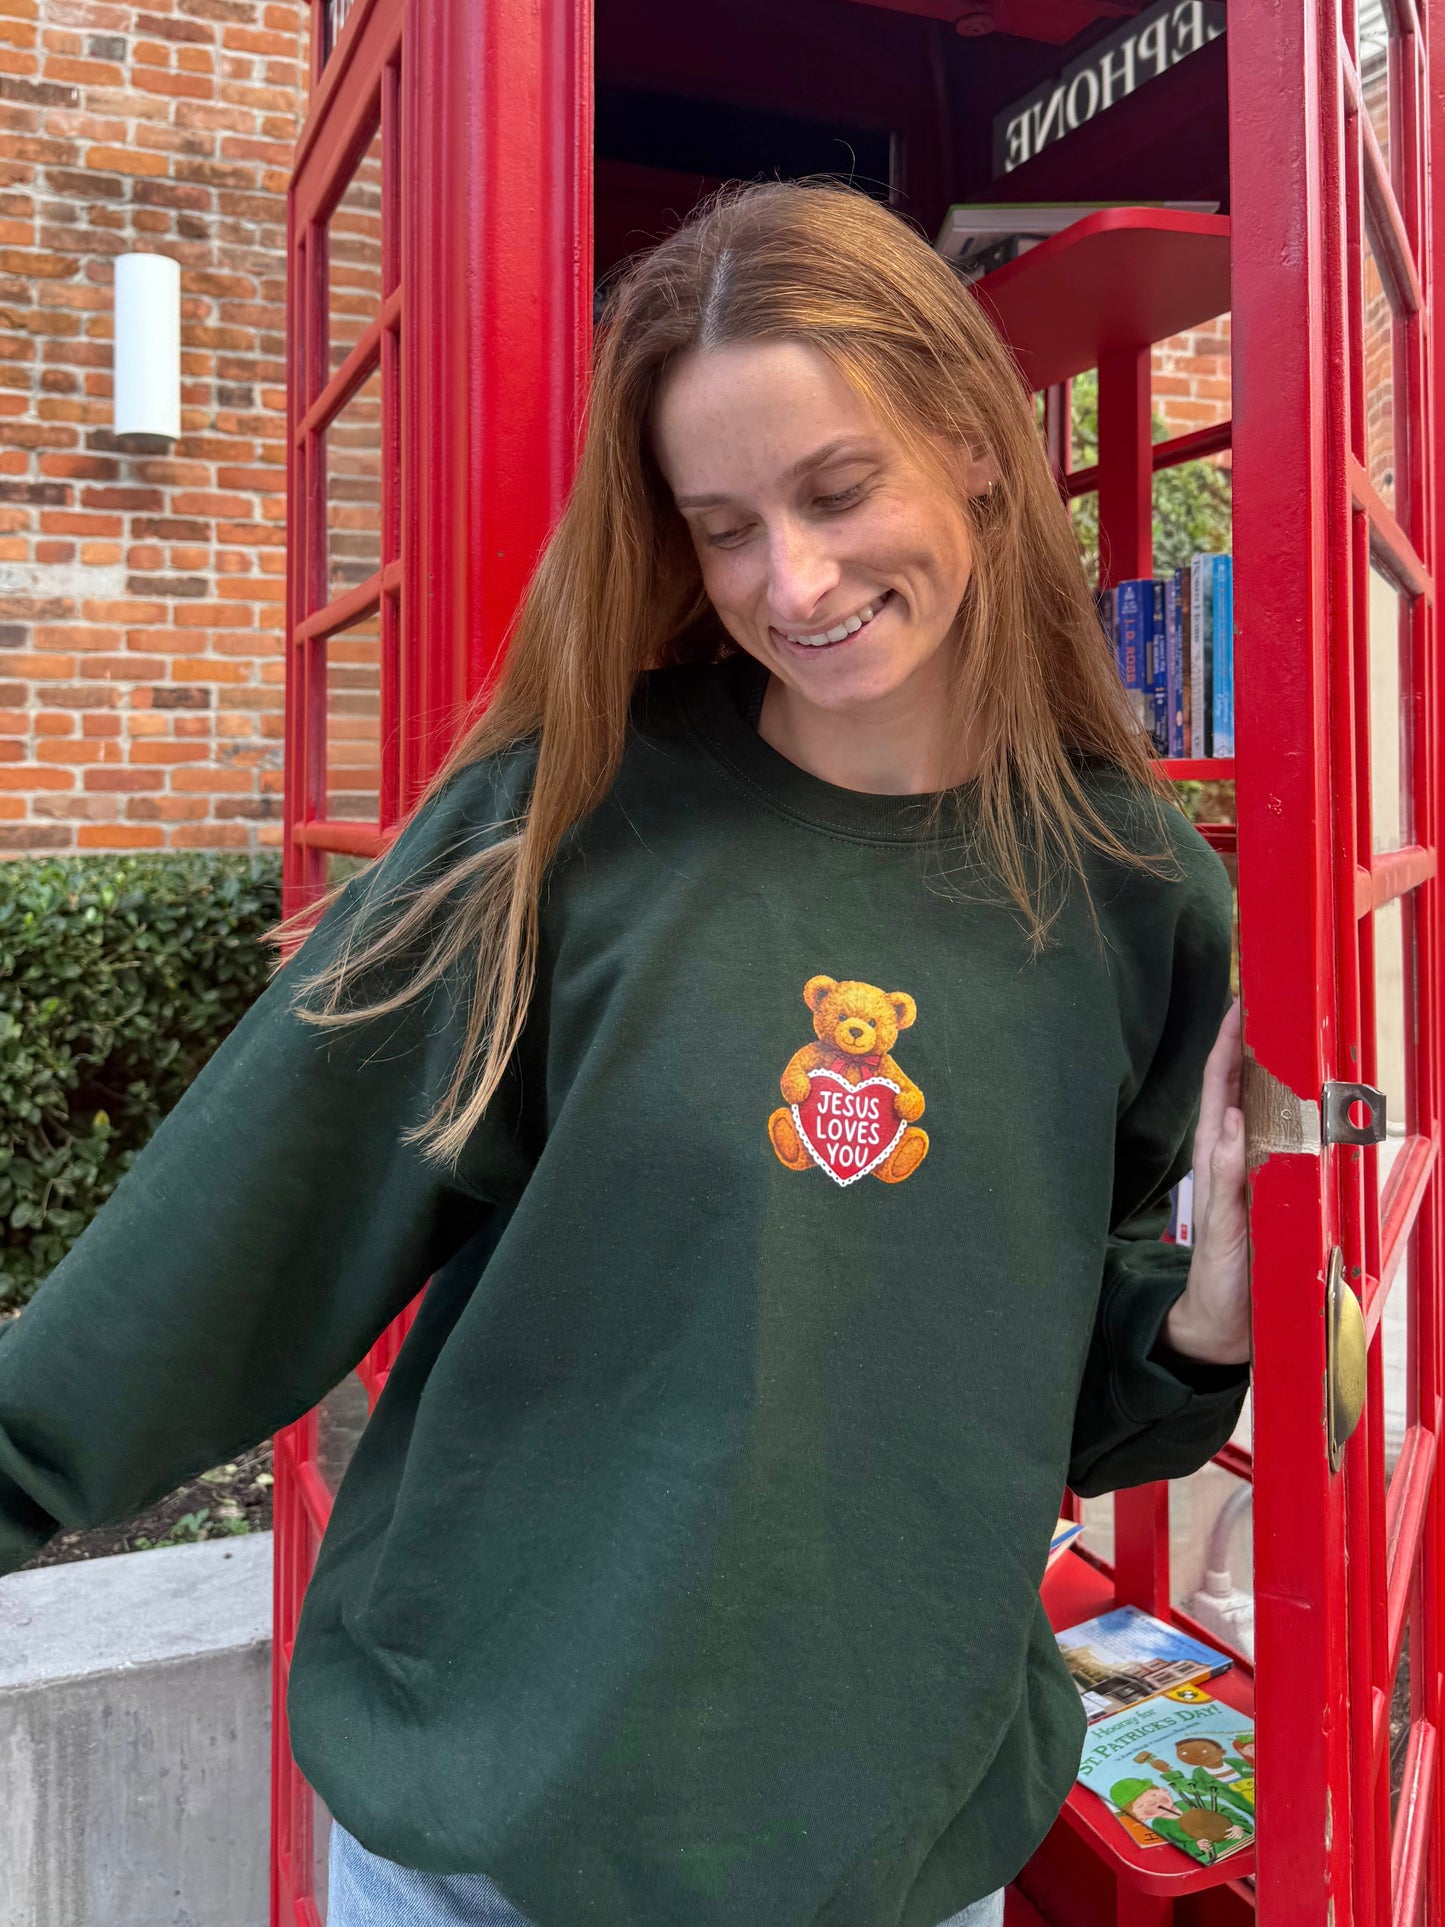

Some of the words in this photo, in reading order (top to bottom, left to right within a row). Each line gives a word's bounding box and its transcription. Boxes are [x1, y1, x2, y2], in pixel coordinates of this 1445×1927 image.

[1125, 646, 1136, 683] ROBB
[817, 1091, 880, 1120] JESUS
[816, 1116, 880, 1144] LOVES
[827, 1142, 869, 1167] YOU
[1091, 1715, 1139, 1739] Hooray
[1135, 1708, 1157, 1721] for
[1174, 1704, 1223, 1722] DAY!
